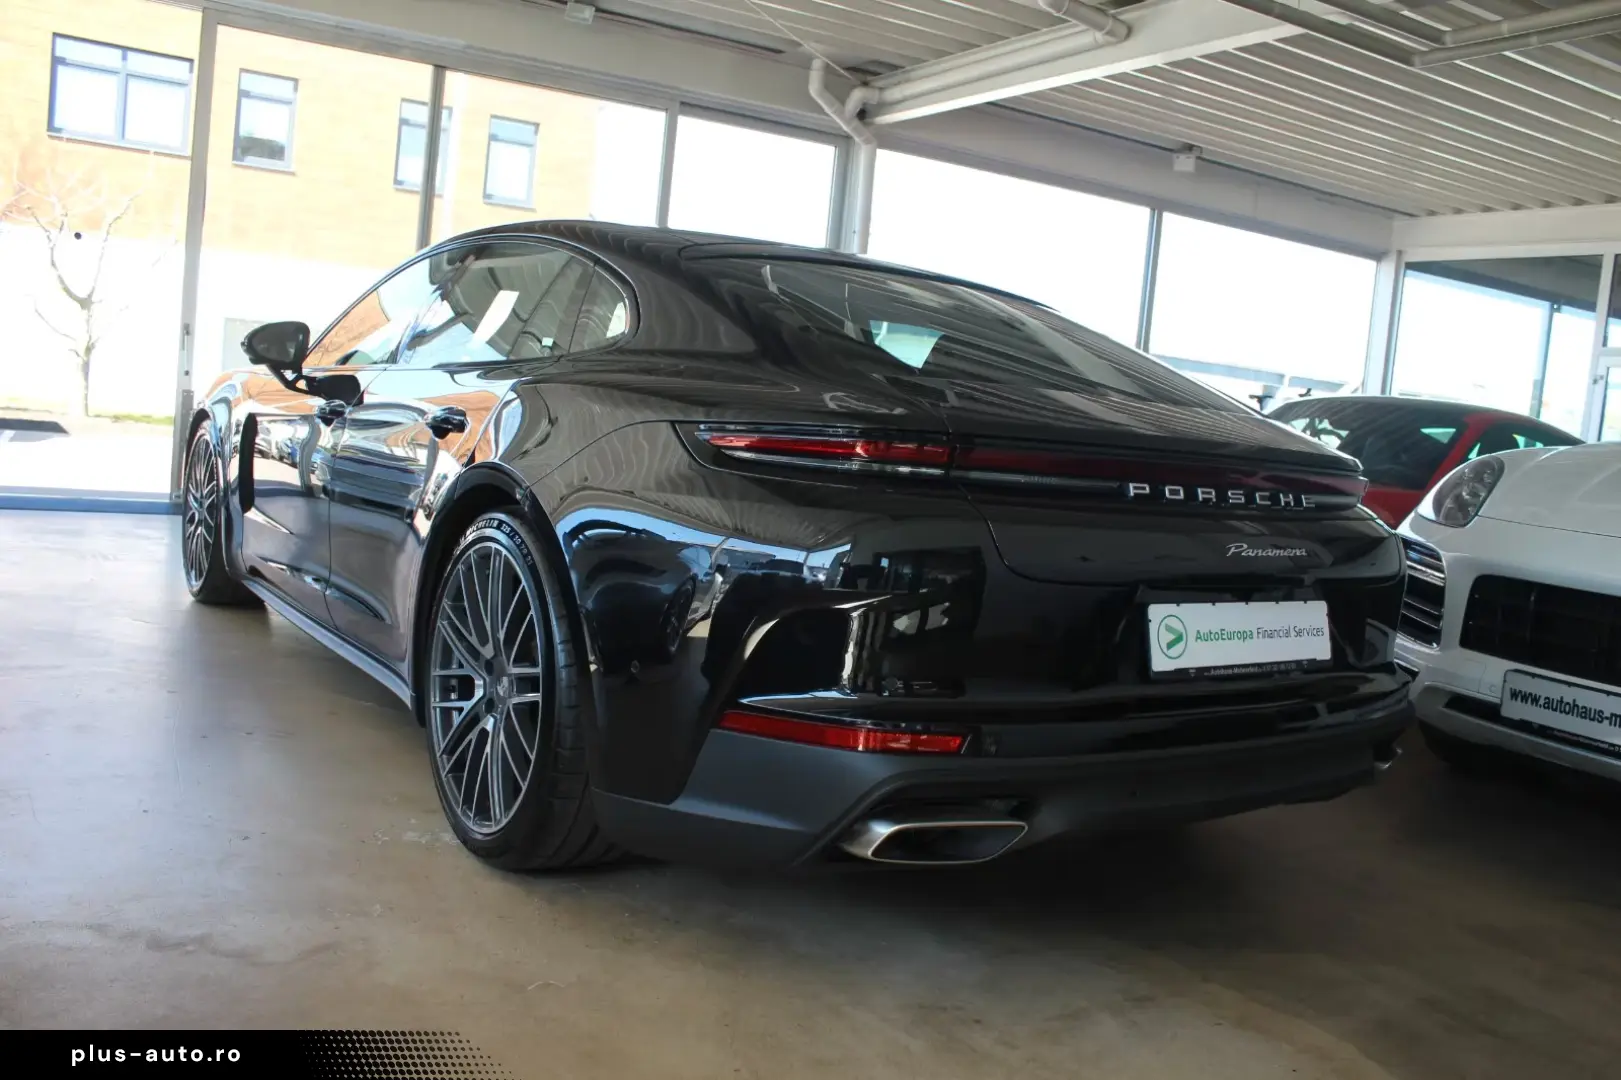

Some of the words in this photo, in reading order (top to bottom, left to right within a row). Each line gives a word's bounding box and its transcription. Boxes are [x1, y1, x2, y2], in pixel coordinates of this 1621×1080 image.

[1129, 482, 1315, 507] PORSCHE
[465, 519, 500, 537] MICHELIN
[1226, 543, 1307, 557] Panamera
[1195, 628, 1254, 643] AutoEuropa
[1256, 626, 1292, 640] Financial
[1293, 624, 1325, 638] Services
